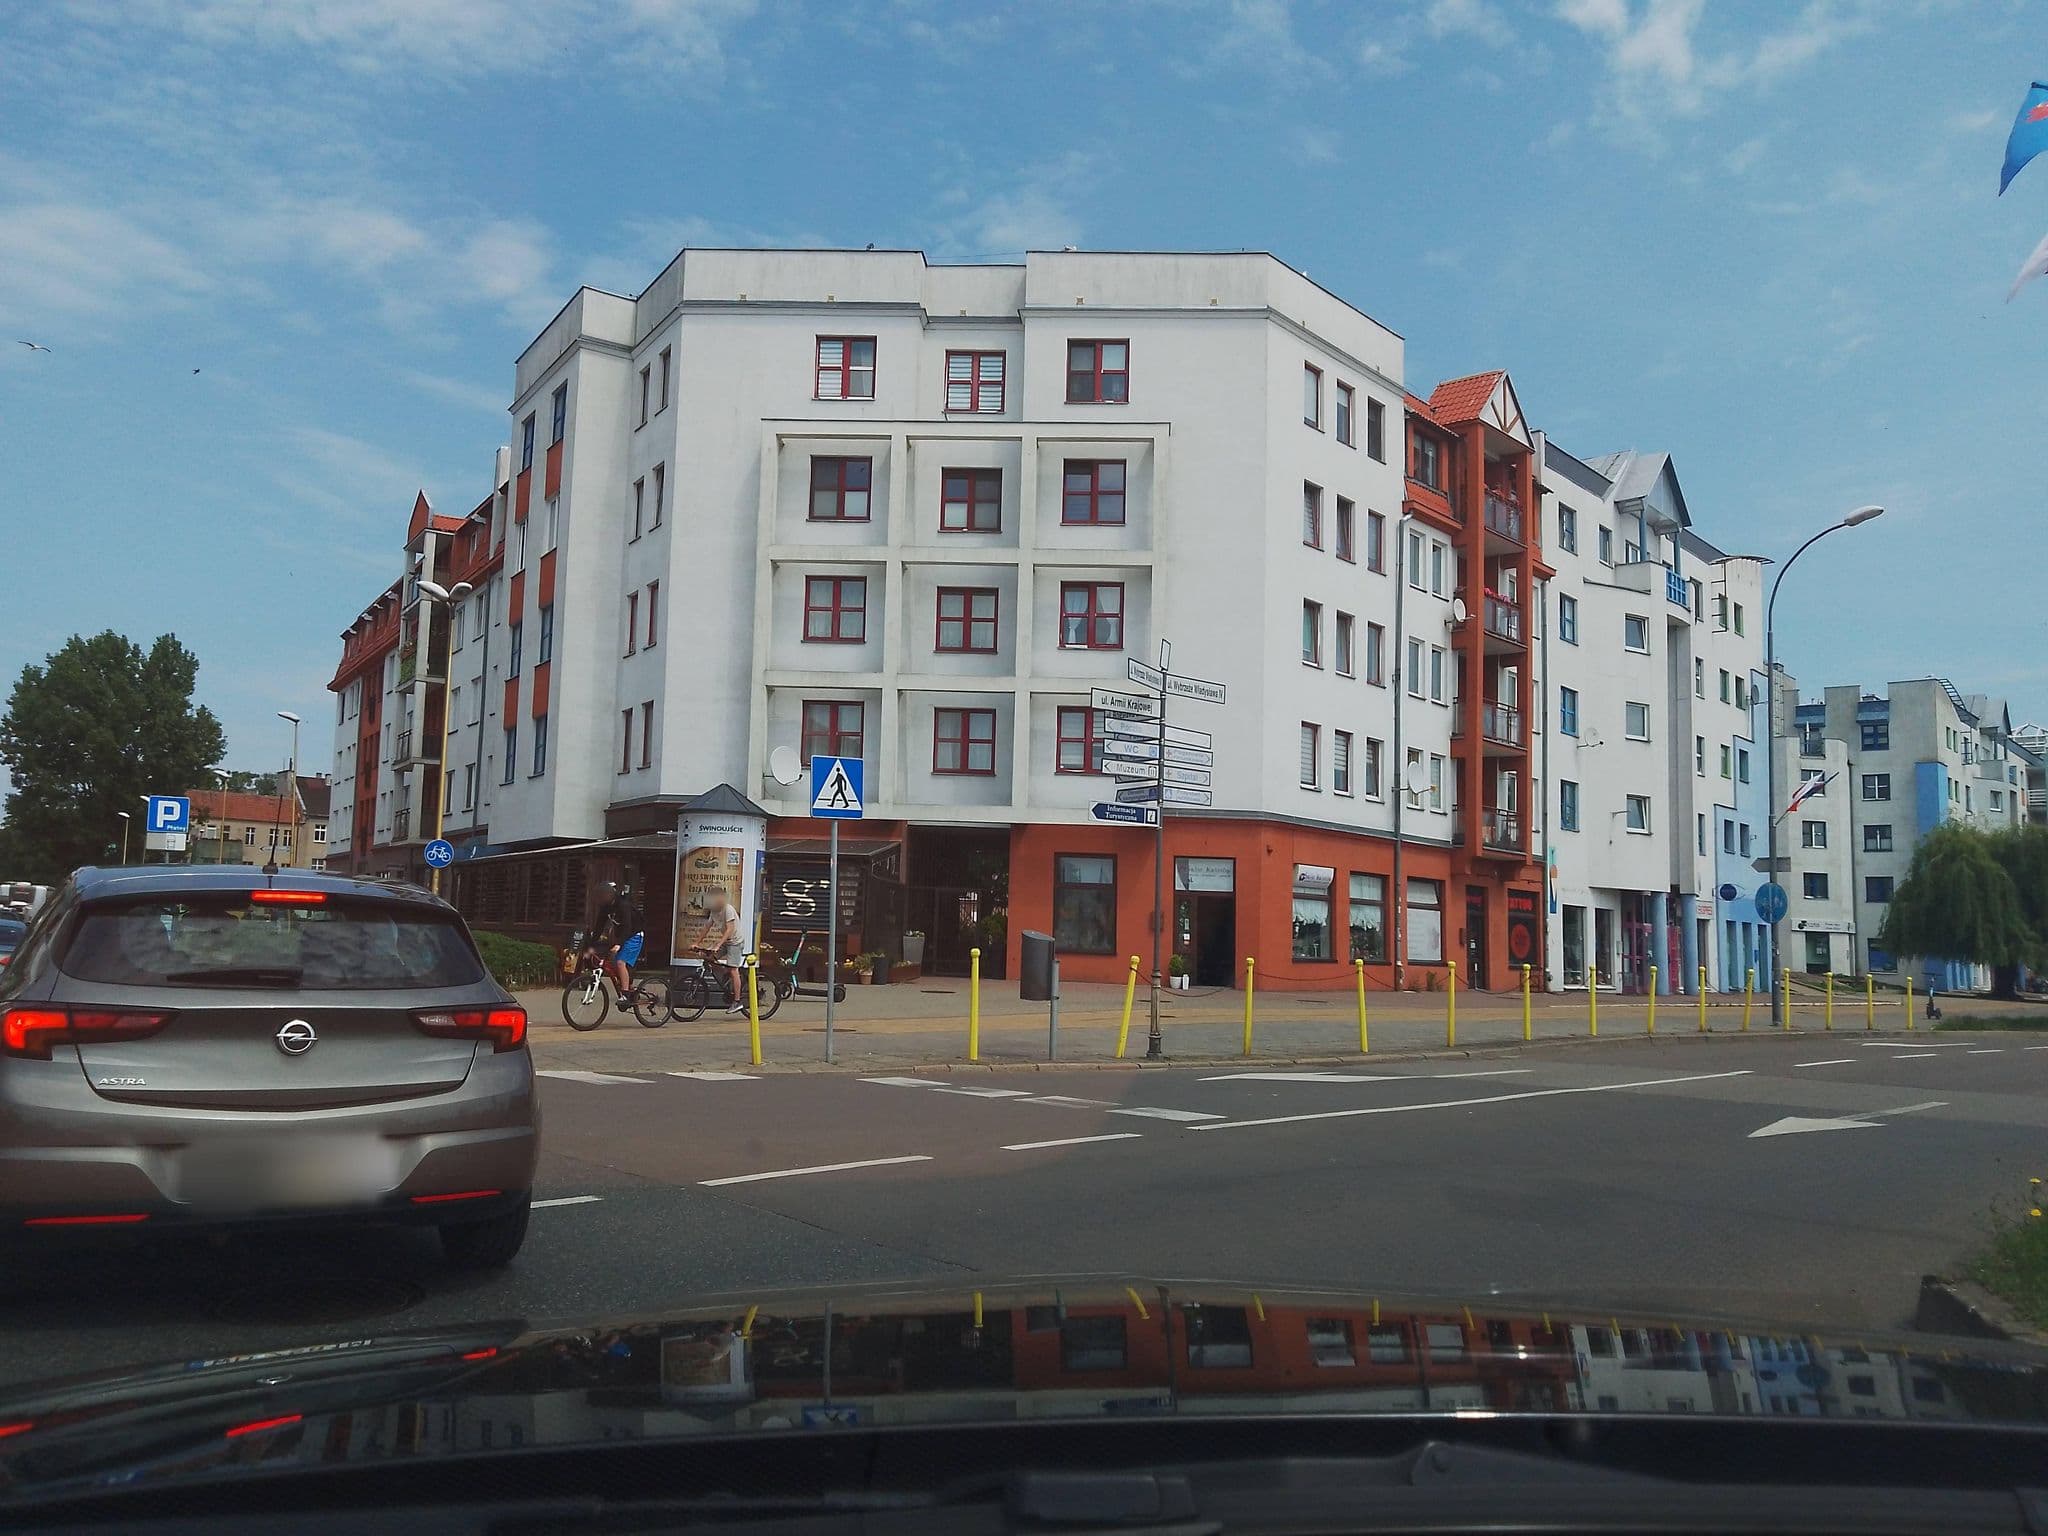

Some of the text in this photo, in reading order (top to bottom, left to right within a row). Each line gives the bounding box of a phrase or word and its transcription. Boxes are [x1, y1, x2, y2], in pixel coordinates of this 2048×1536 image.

[1101, 695, 1153, 715] ul. Armii Krajowej
[1124, 744, 1140, 754] WC
[1116, 763, 1146, 775] Muzeum
[156, 800, 181, 828] P
[1107, 804, 1136, 815] Informacja
[1105, 812, 1137, 822] Turystyczna
[699, 824, 744, 833] ŚWINOUJŚCIE
[98, 1077, 147, 1086] ASTRA
